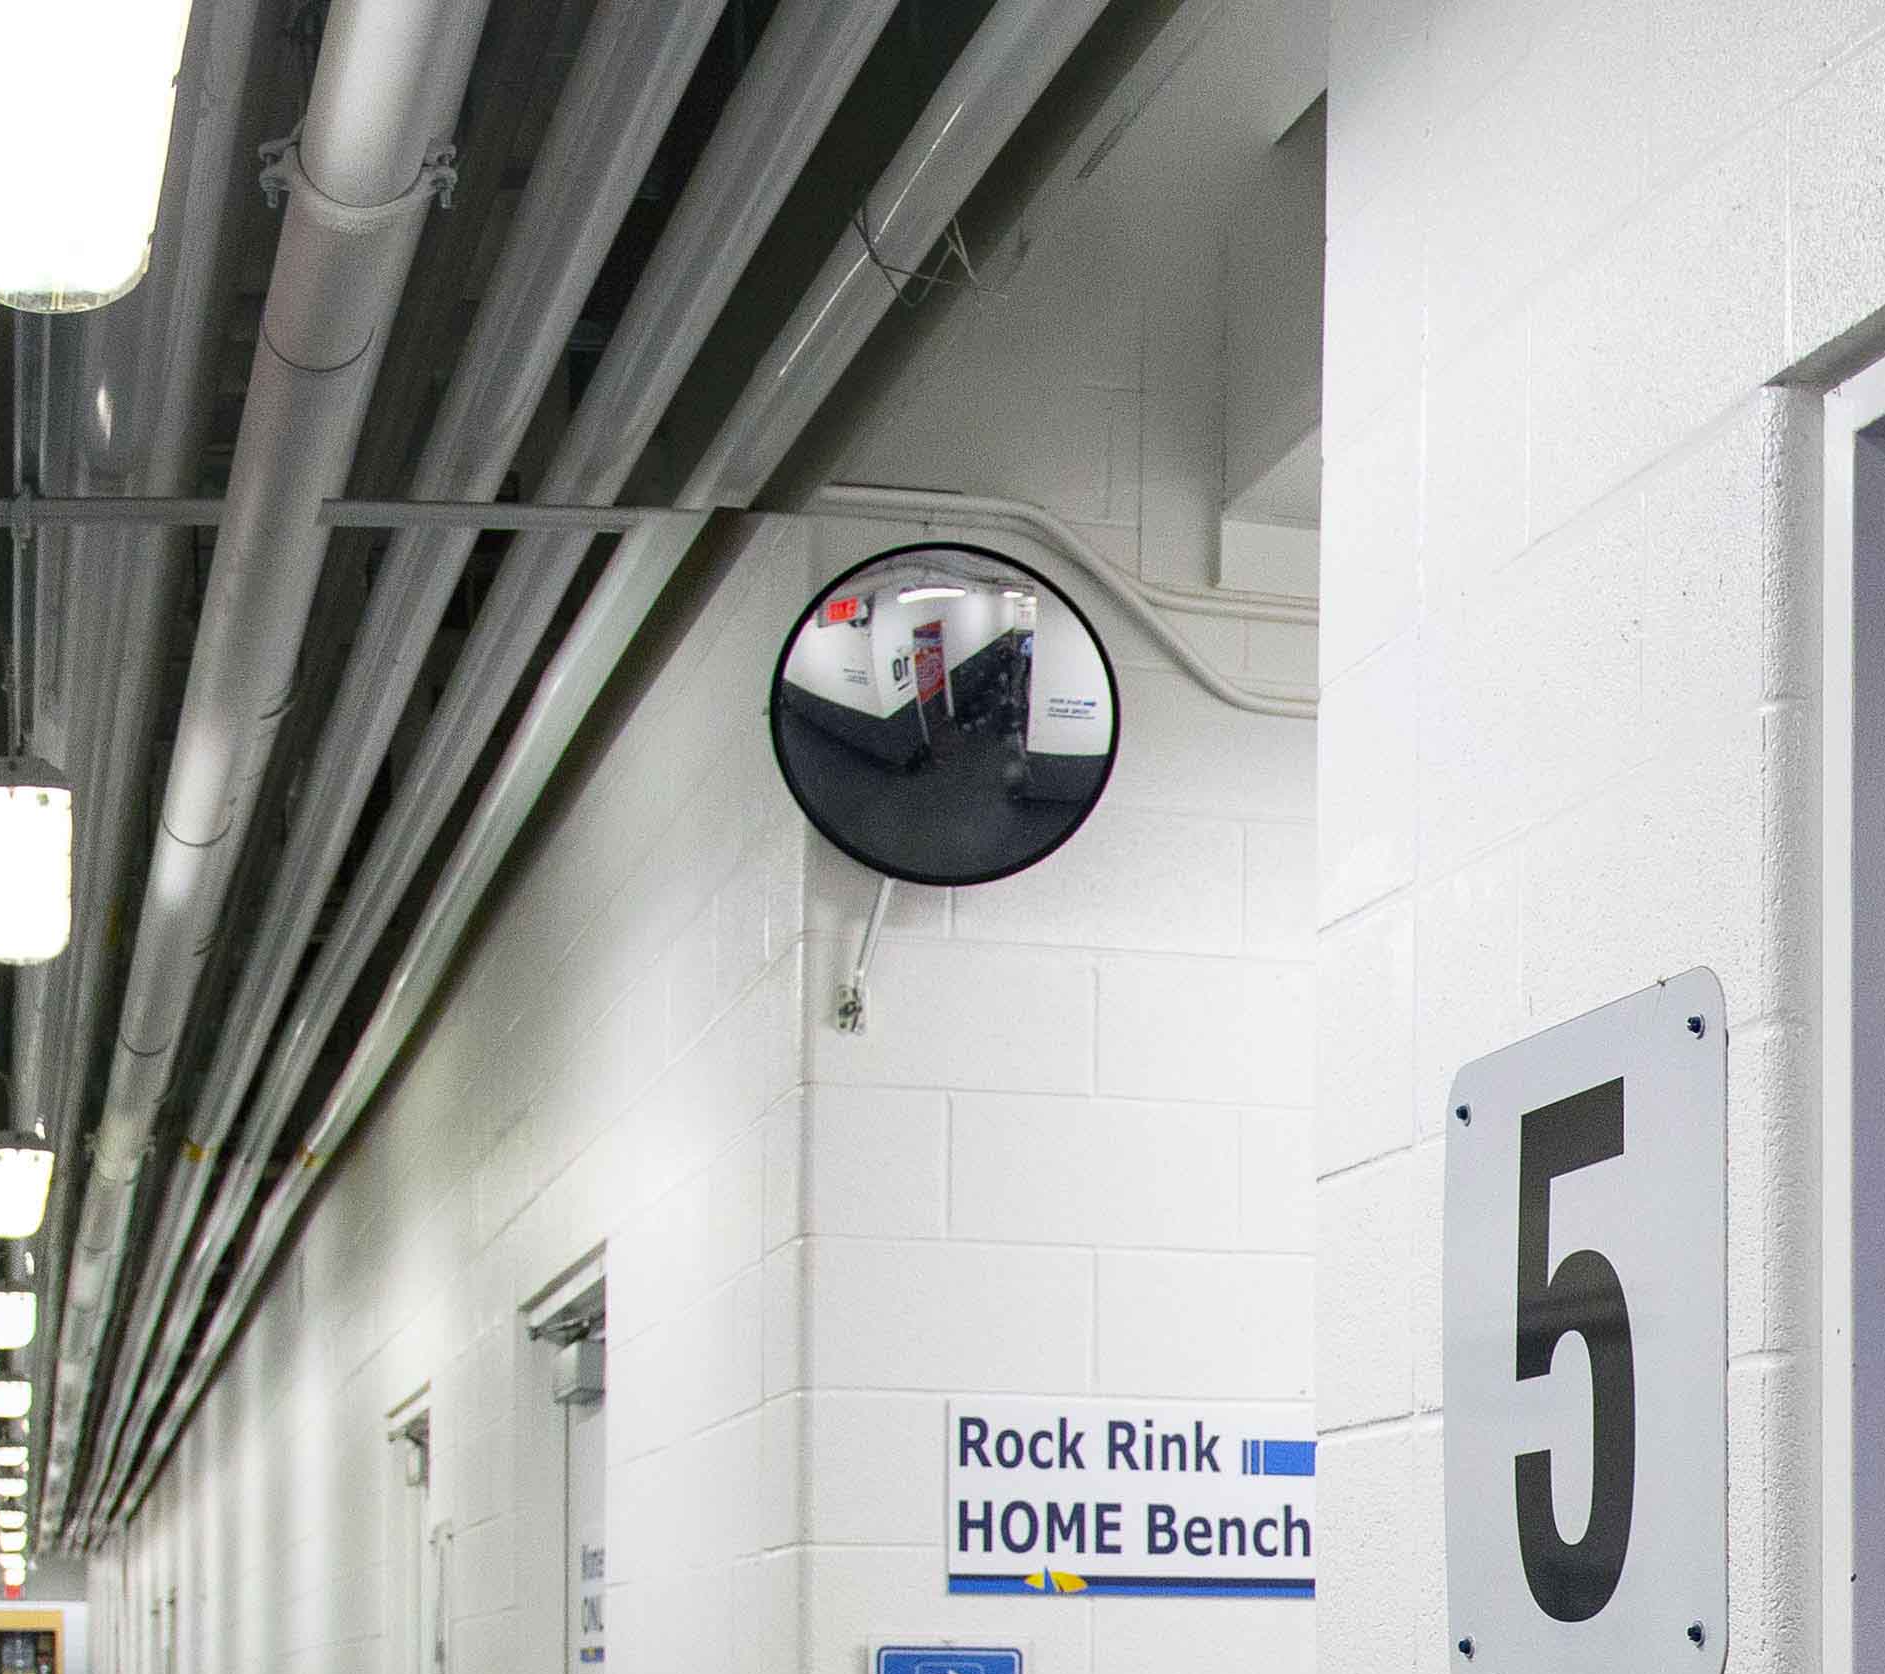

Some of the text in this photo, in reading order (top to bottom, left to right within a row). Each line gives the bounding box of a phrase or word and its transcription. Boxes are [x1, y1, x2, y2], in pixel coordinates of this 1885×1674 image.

[1514, 1076, 1636, 1624] 5
[957, 1416, 1221, 1474] Rock Rink
[956, 1500, 1311, 1558] HOME Bench
